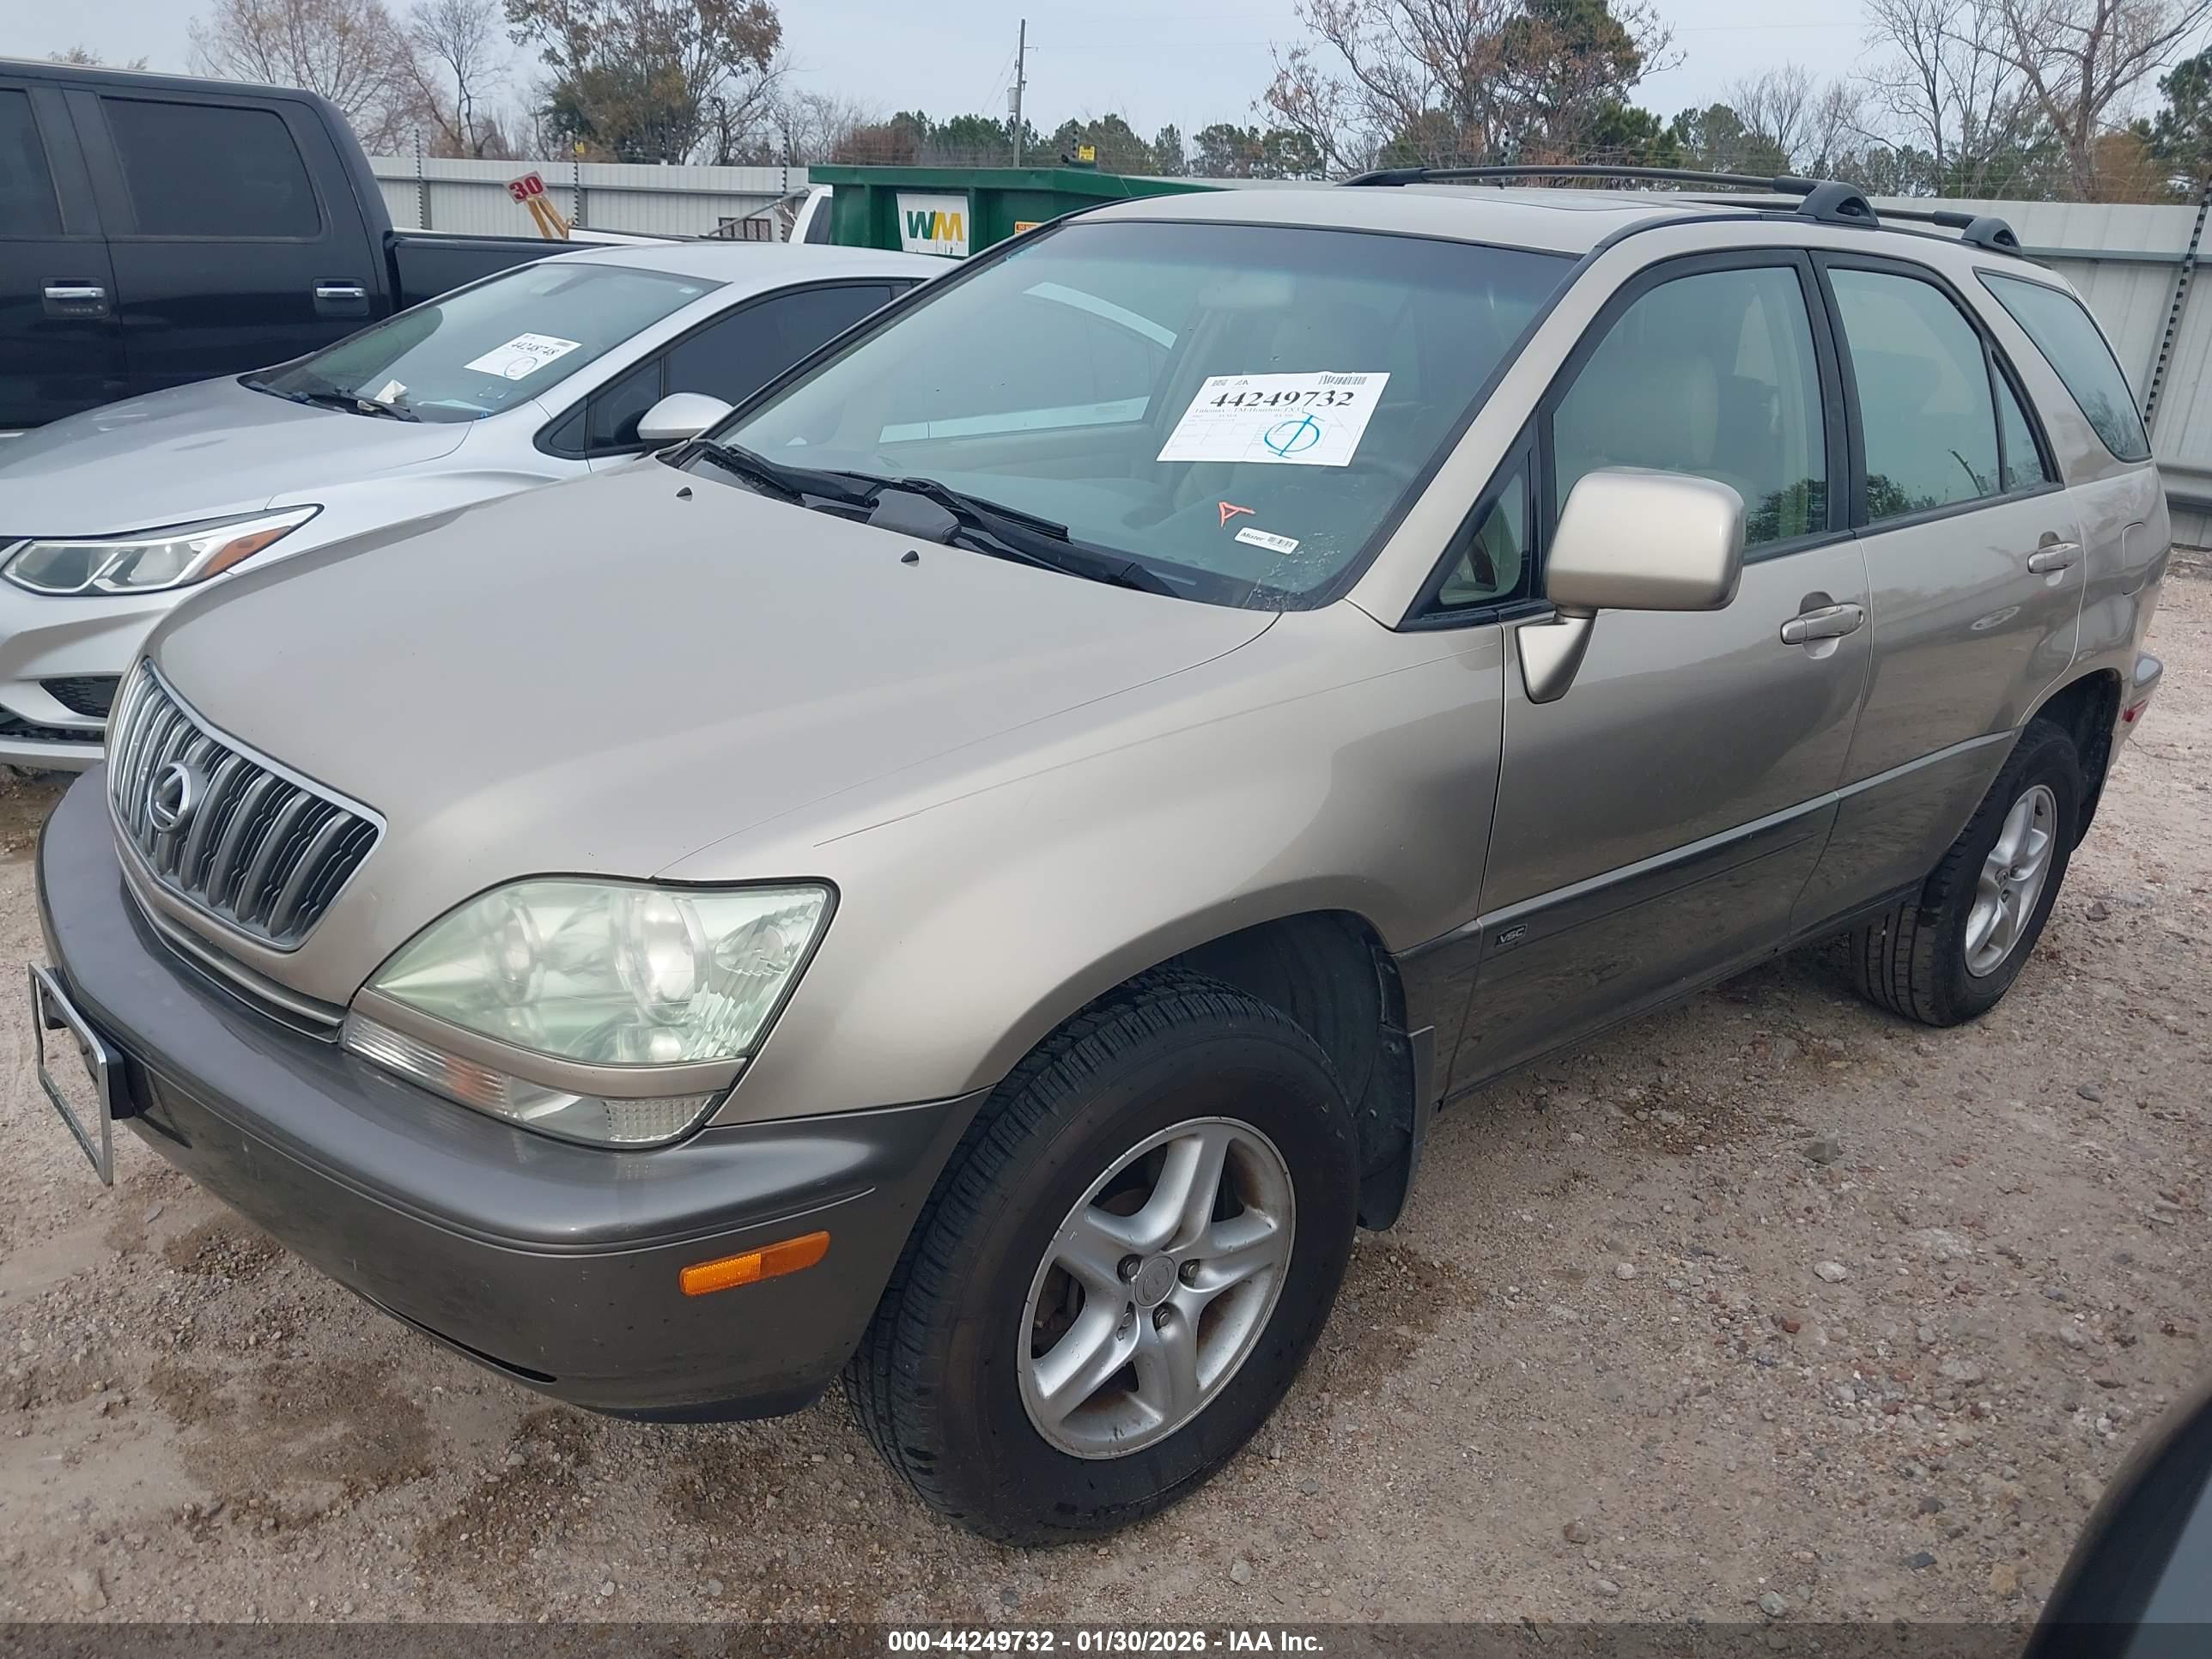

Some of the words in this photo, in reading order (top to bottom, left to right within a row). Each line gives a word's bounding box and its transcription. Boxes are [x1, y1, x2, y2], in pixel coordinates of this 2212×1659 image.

[508, 176, 544, 200] 30
[906, 210, 963, 242] WM
[1209, 390, 1355, 408] 44249732
[1499, 927, 1525, 943] VSC
